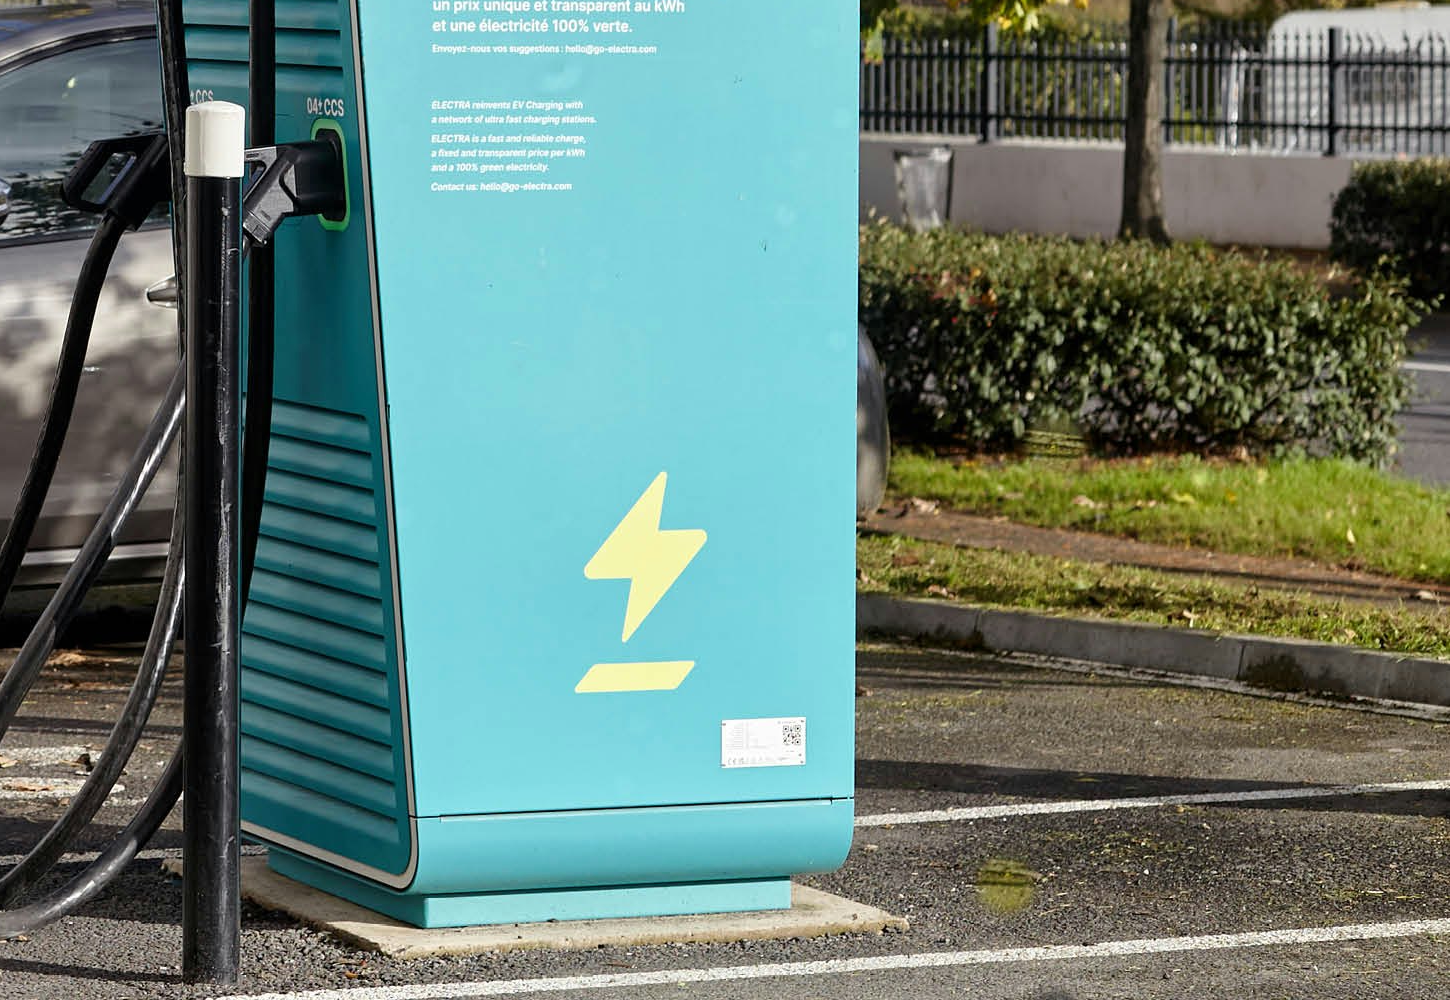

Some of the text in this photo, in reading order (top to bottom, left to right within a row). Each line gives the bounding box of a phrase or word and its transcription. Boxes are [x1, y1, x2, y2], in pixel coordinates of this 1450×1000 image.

[432, 0, 451, 12] un
[534, 0, 548, 12] et
[550, 0, 631, 15] transparent
[634, 1, 652, 13] au
[654, 0, 685, 13] kWh
[432, 18, 633, 33] et une électricité 100% verte.
[432, 44, 491, 54] Envoyez-nous
[492, 45, 508, 53] vos
[509, 45, 560, 55] suggestions
[307, 97, 345, 117] 04 CCS
[431, 100, 584, 111] ELECTRA reinvents EV Charging with
[438, 115, 473, 124] network
[474, 114, 484, 123] of
[484, 115, 505, 123] ultra
[505, 114, 522, 123] fast
[523, 115, 561, 125] charging
[561, 114, 596, 123] stations.
[431, 134, 470, 143] ELECTRA
[488, 134, 504, 143] fast
[505, 134, 522, 142] and
[522, 134, 555, 143] reliable
[555, 135, 586, 145] charge,
[438, 148, 460, 157] fixed
[460, 149, 477, 157] and
[478, 149, 527, 158] transparent
[528, 149, 550, 158] price
[550, 149, 566, 158] per
[566, 148, 586, 157] kWh
[431, 163, 448, 172] and
[456, 162, 479, 171] 100%
[480, 164, 504, 173] green
[505, 163, 549, 172] electricity.
[431, 182, 465, 191] Contact
[465, 183, 478, 191] us:
